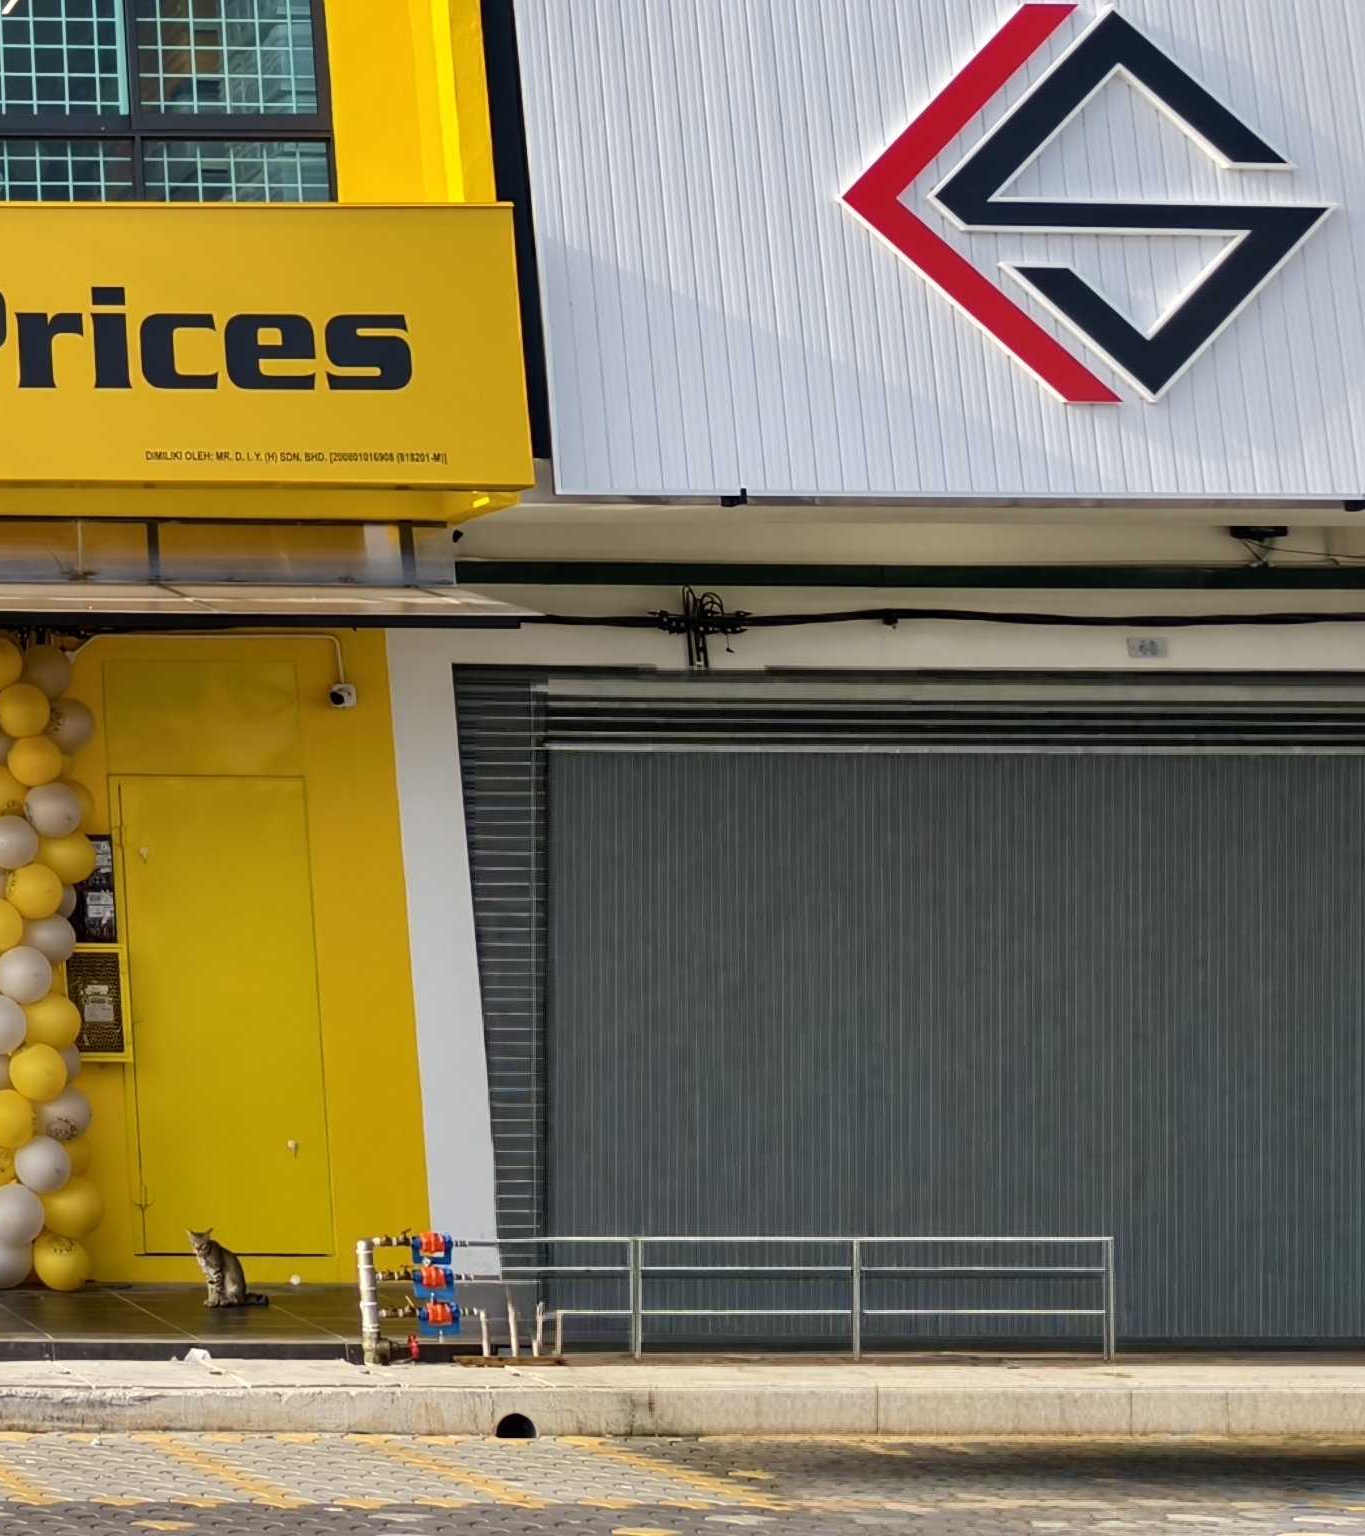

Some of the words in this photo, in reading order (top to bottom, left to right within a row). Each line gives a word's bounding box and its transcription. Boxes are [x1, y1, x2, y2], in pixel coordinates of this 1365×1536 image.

[185, 450, 214, 461] OLEH:
[280, 451, 302, 462] SDN.
[304, 452, 328, 462] BHD.
